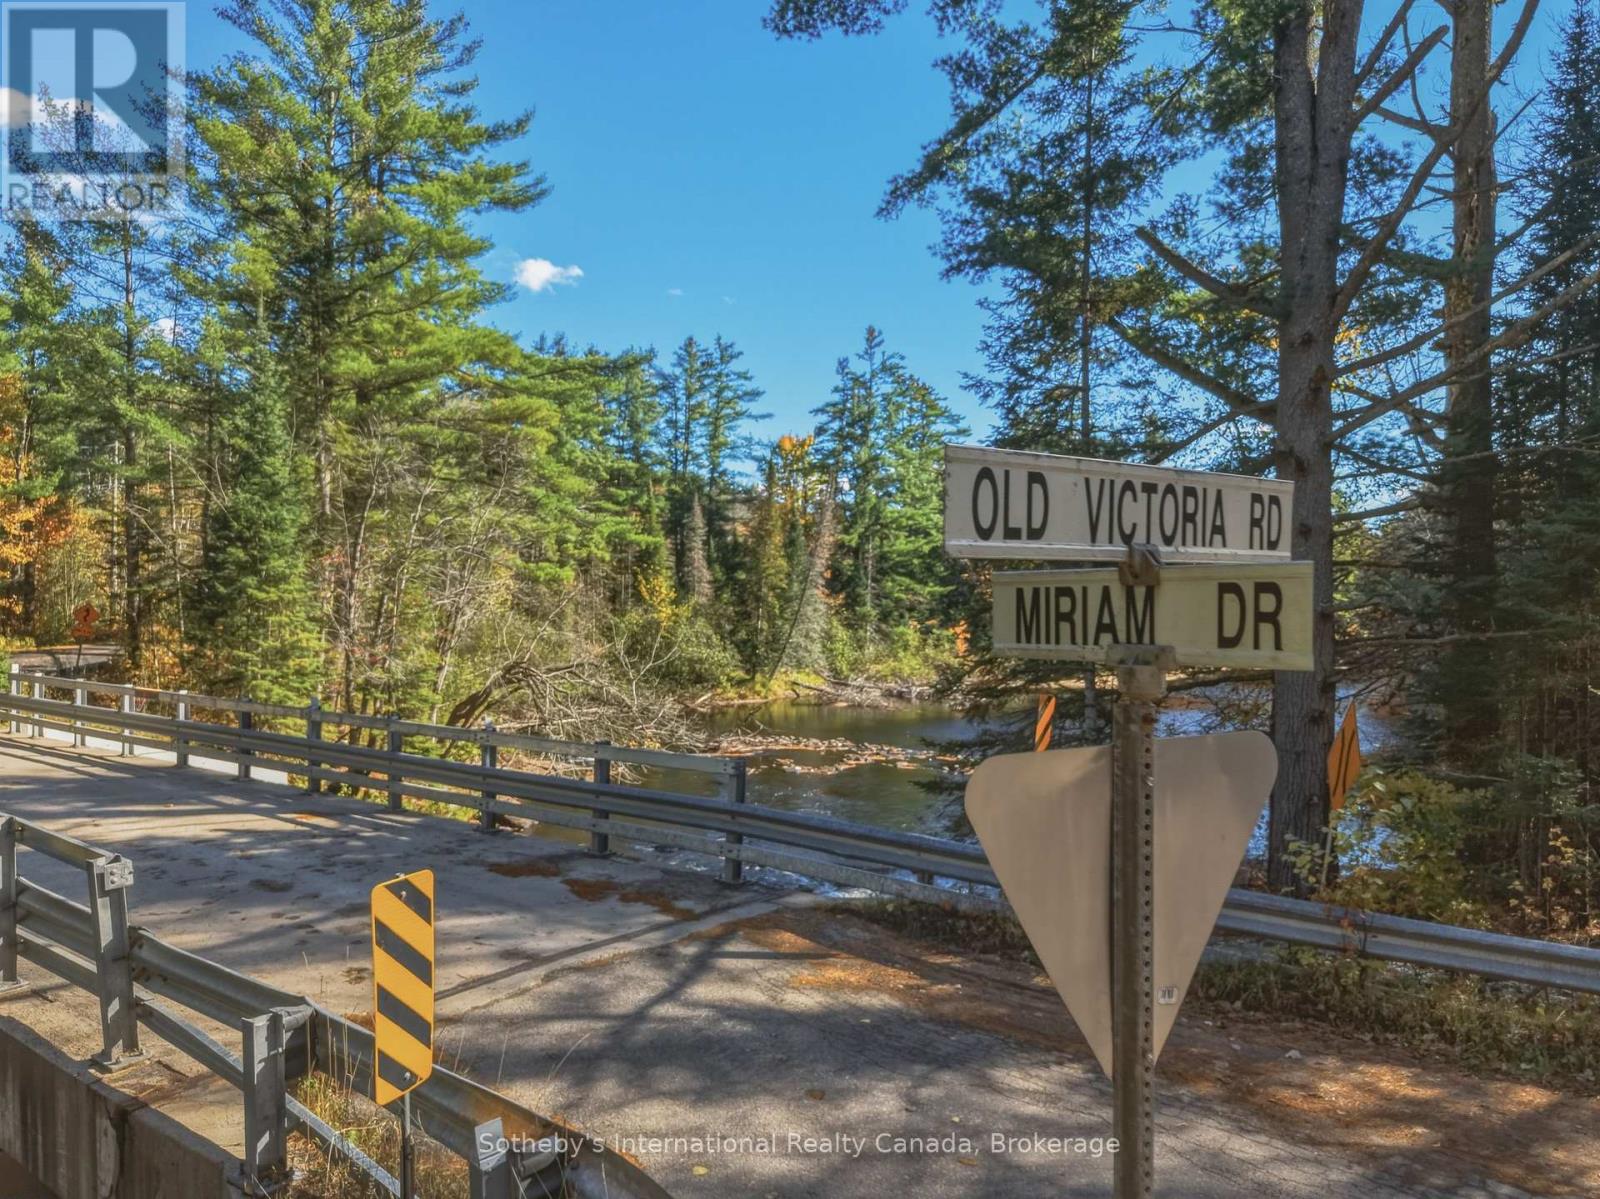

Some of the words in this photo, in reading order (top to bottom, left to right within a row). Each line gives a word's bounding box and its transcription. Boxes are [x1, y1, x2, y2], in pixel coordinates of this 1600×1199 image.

[972, 466, 1049, 541] OLD
[1085, 477, 1226, 548] VICTORIA
[1250, 493, 1282, 551] RD
[1015, 585, 1155, 646] MIRIAM
[1217, 581, 1283, 651] DR
